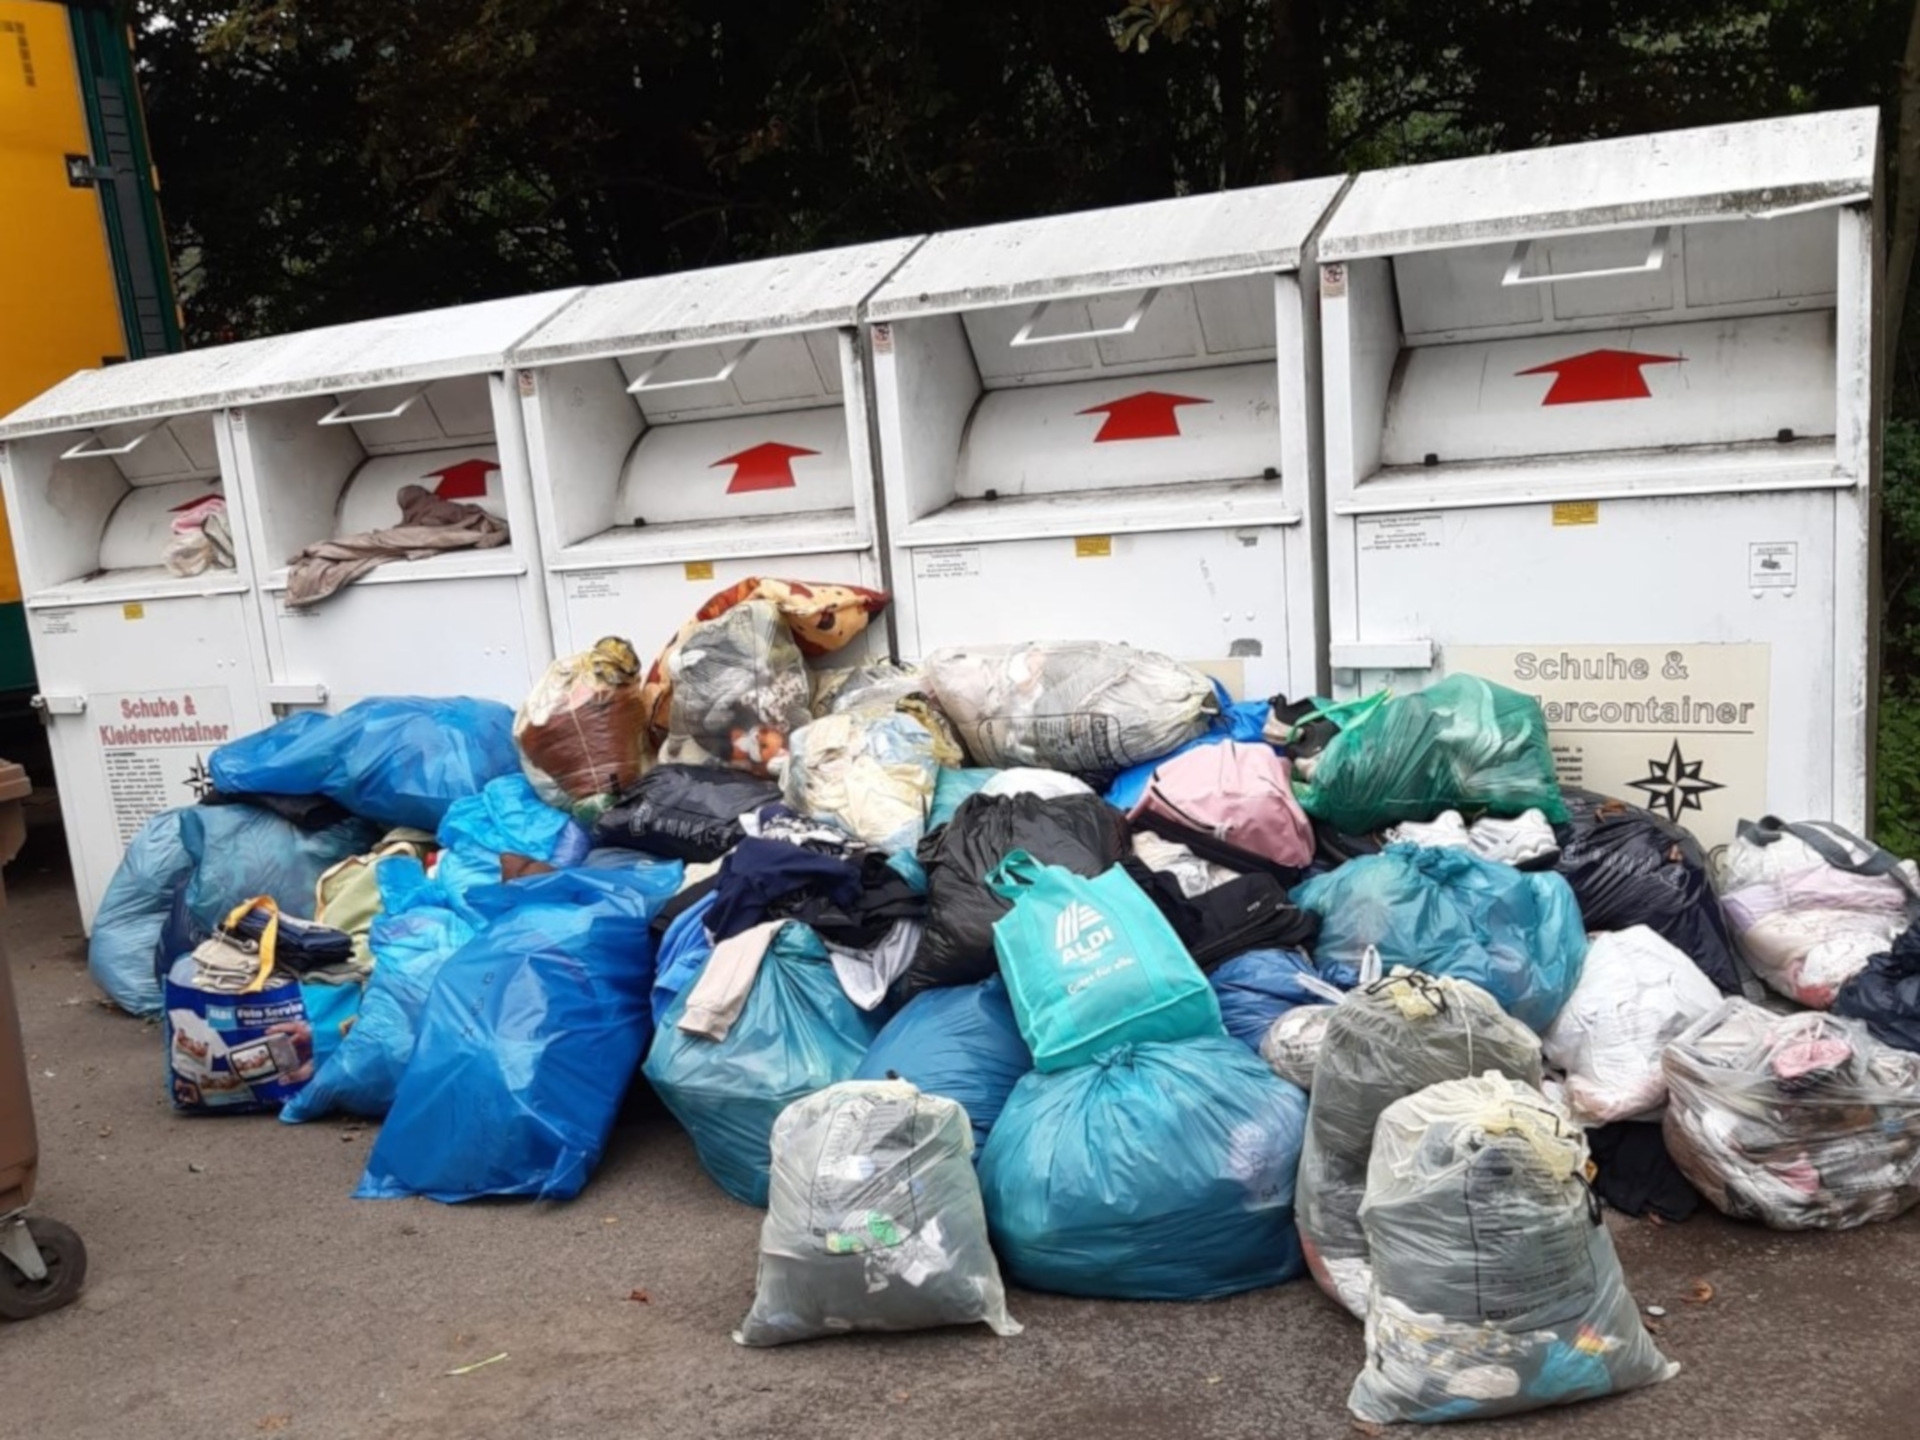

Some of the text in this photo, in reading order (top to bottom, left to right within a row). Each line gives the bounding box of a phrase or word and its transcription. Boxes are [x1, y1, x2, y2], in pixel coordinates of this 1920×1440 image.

[1513, 651, 1690, 680] Schuhe &
[121, 695, 196, 718] Schuhe &
[1536, 695, 1755, 724] ercontainer
[100, 721, 228, 745] Kleidercontainer
[1062, 926, 1114, 965] ALDI
